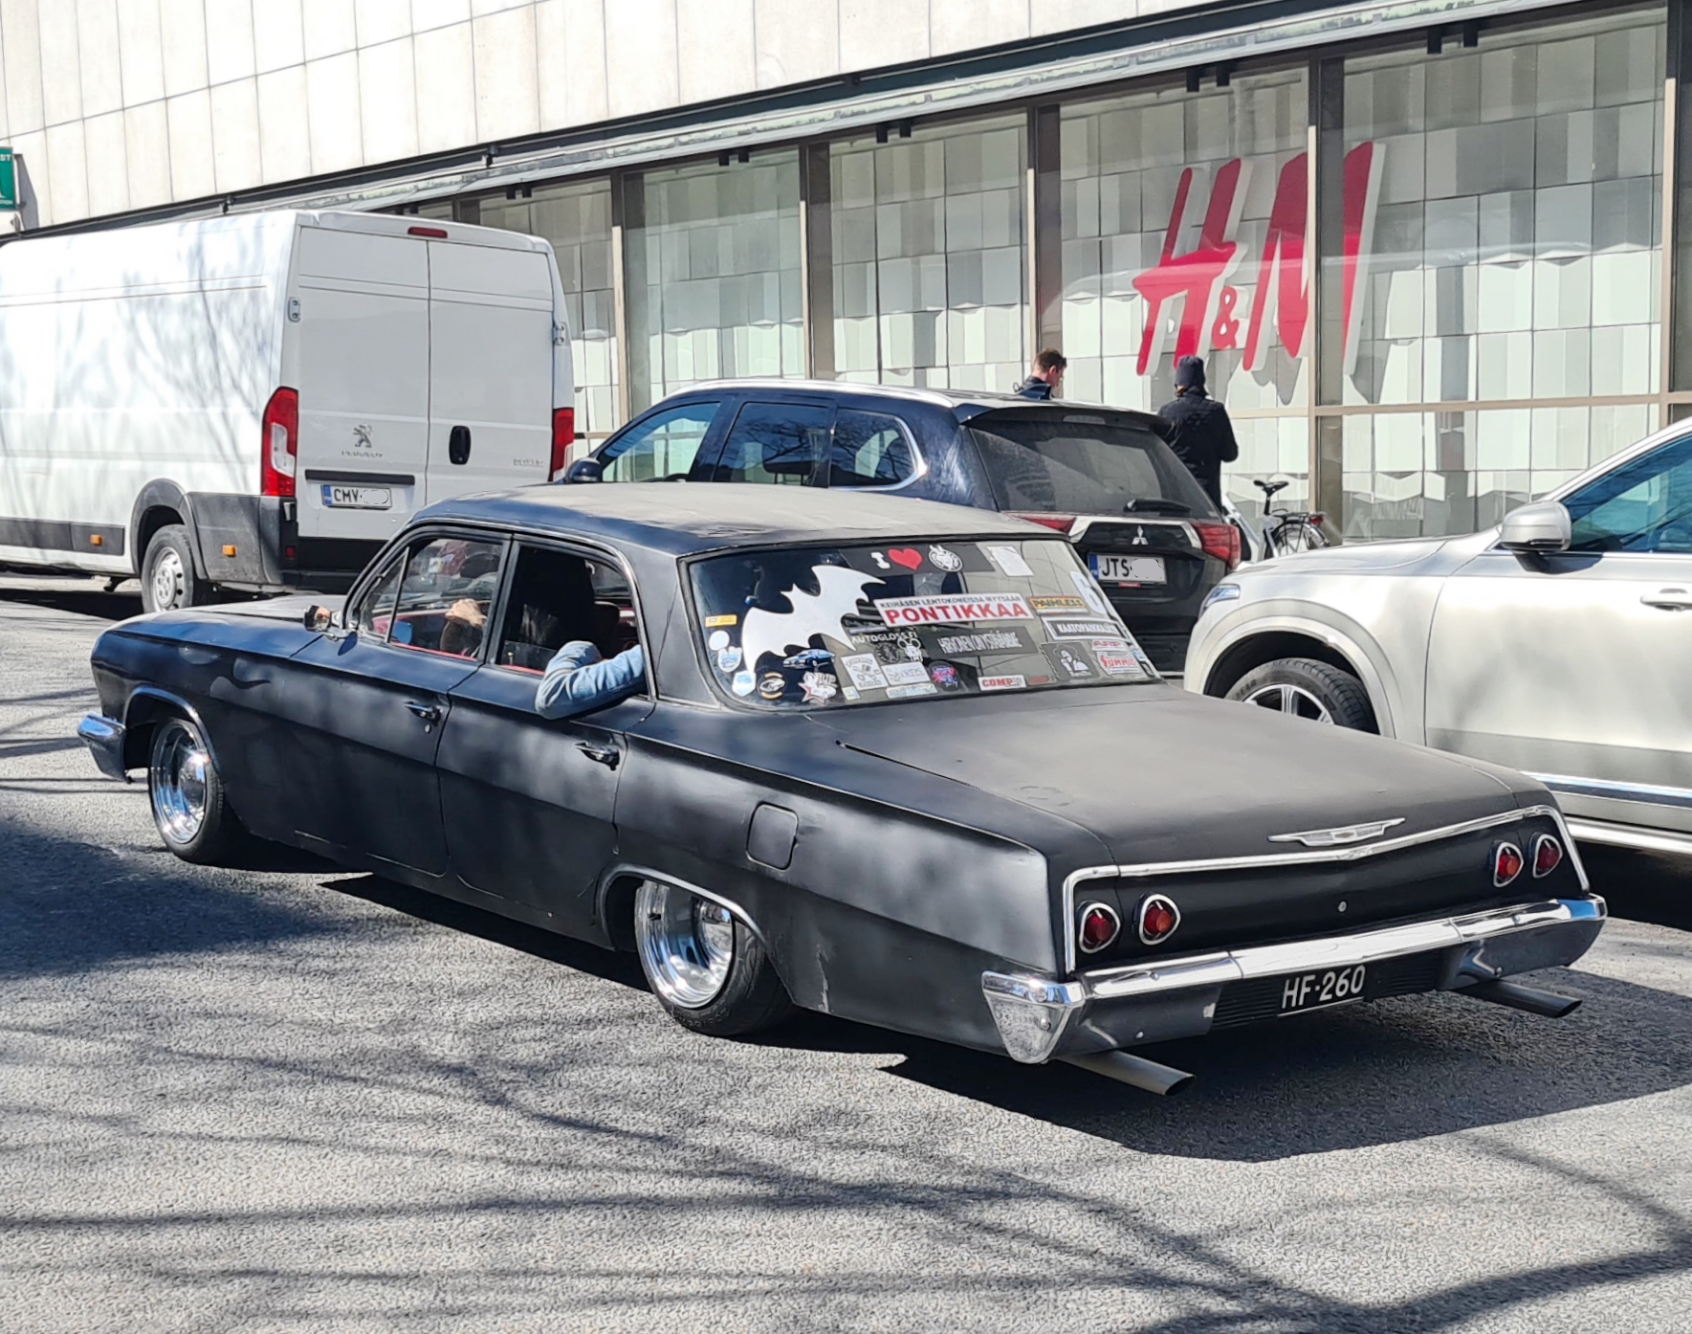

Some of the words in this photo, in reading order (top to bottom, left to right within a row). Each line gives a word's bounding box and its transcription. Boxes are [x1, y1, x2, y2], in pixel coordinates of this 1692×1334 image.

[1132, 141, 1376, 375] H&M
[884, 603, 1029, 624] PONTIKKAA
[851, 631, 918, 645] AUTOGLOSS.FI
[982, 678, 1013, 687] COMP
[1281, 964, 1366, 1009] HF-260
